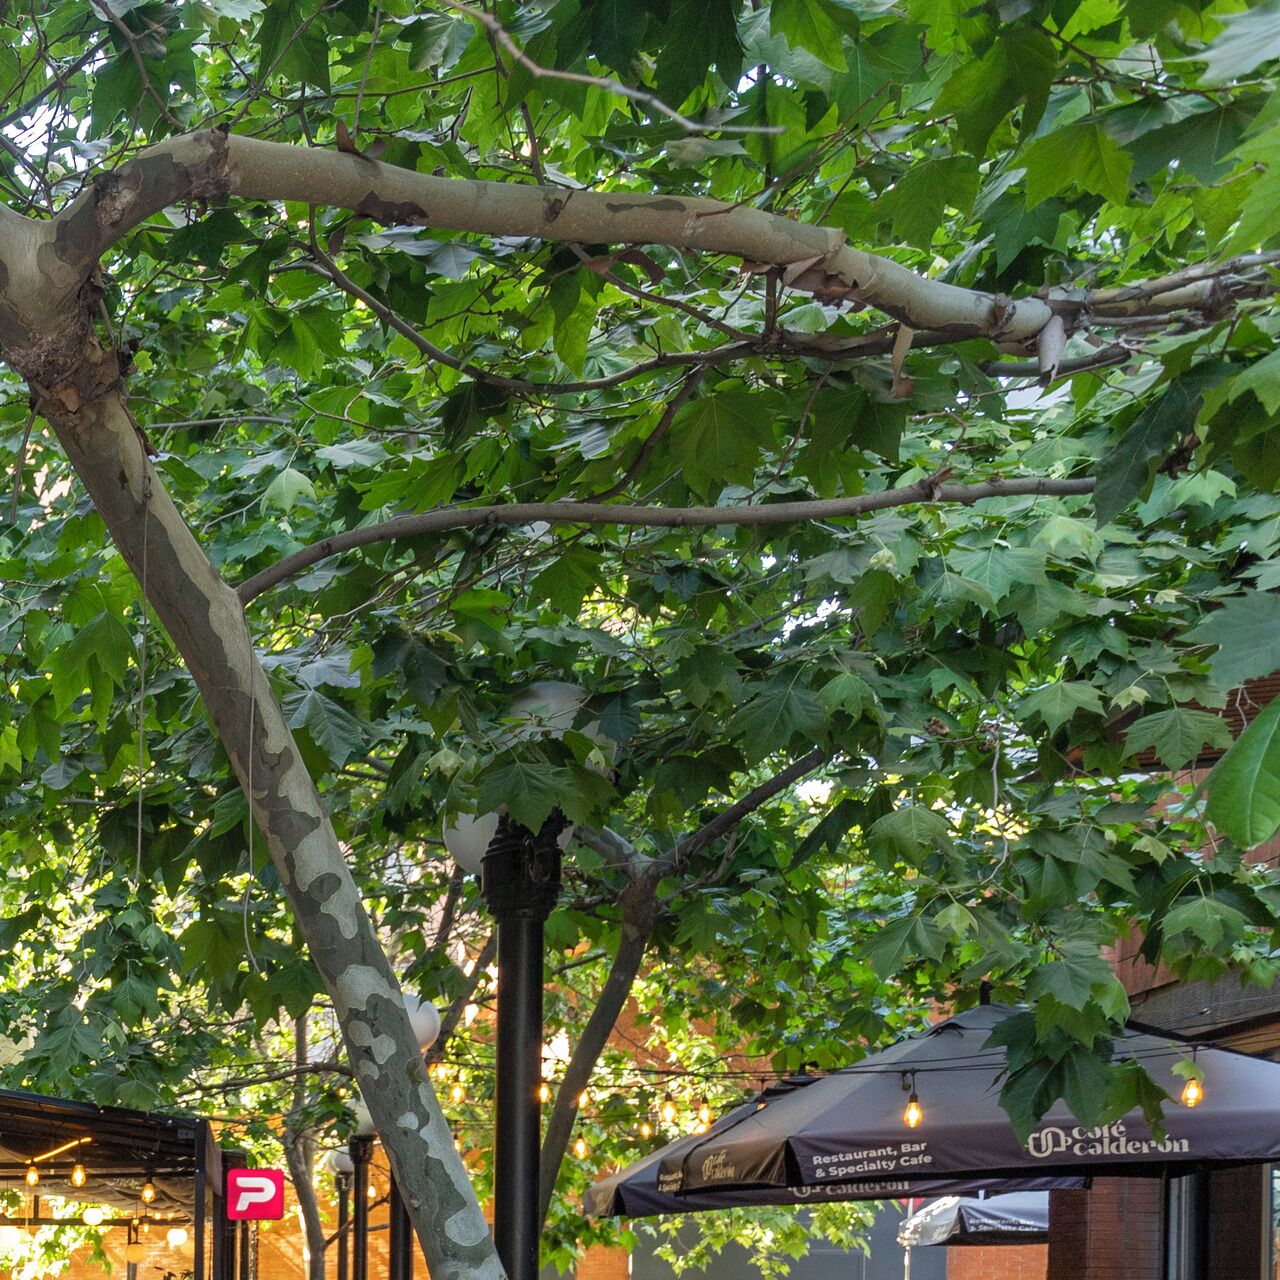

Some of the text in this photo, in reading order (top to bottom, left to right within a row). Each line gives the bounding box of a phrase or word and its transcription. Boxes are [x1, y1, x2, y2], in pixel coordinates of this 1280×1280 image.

[812, 1142, 928, 1165] Restaurant, Bar
[1073, 1134, 1190, 1157] calderón
[815, 1154, 933, 1178] & Specialty Cafe
[236, 1177, 276, 1211] P
